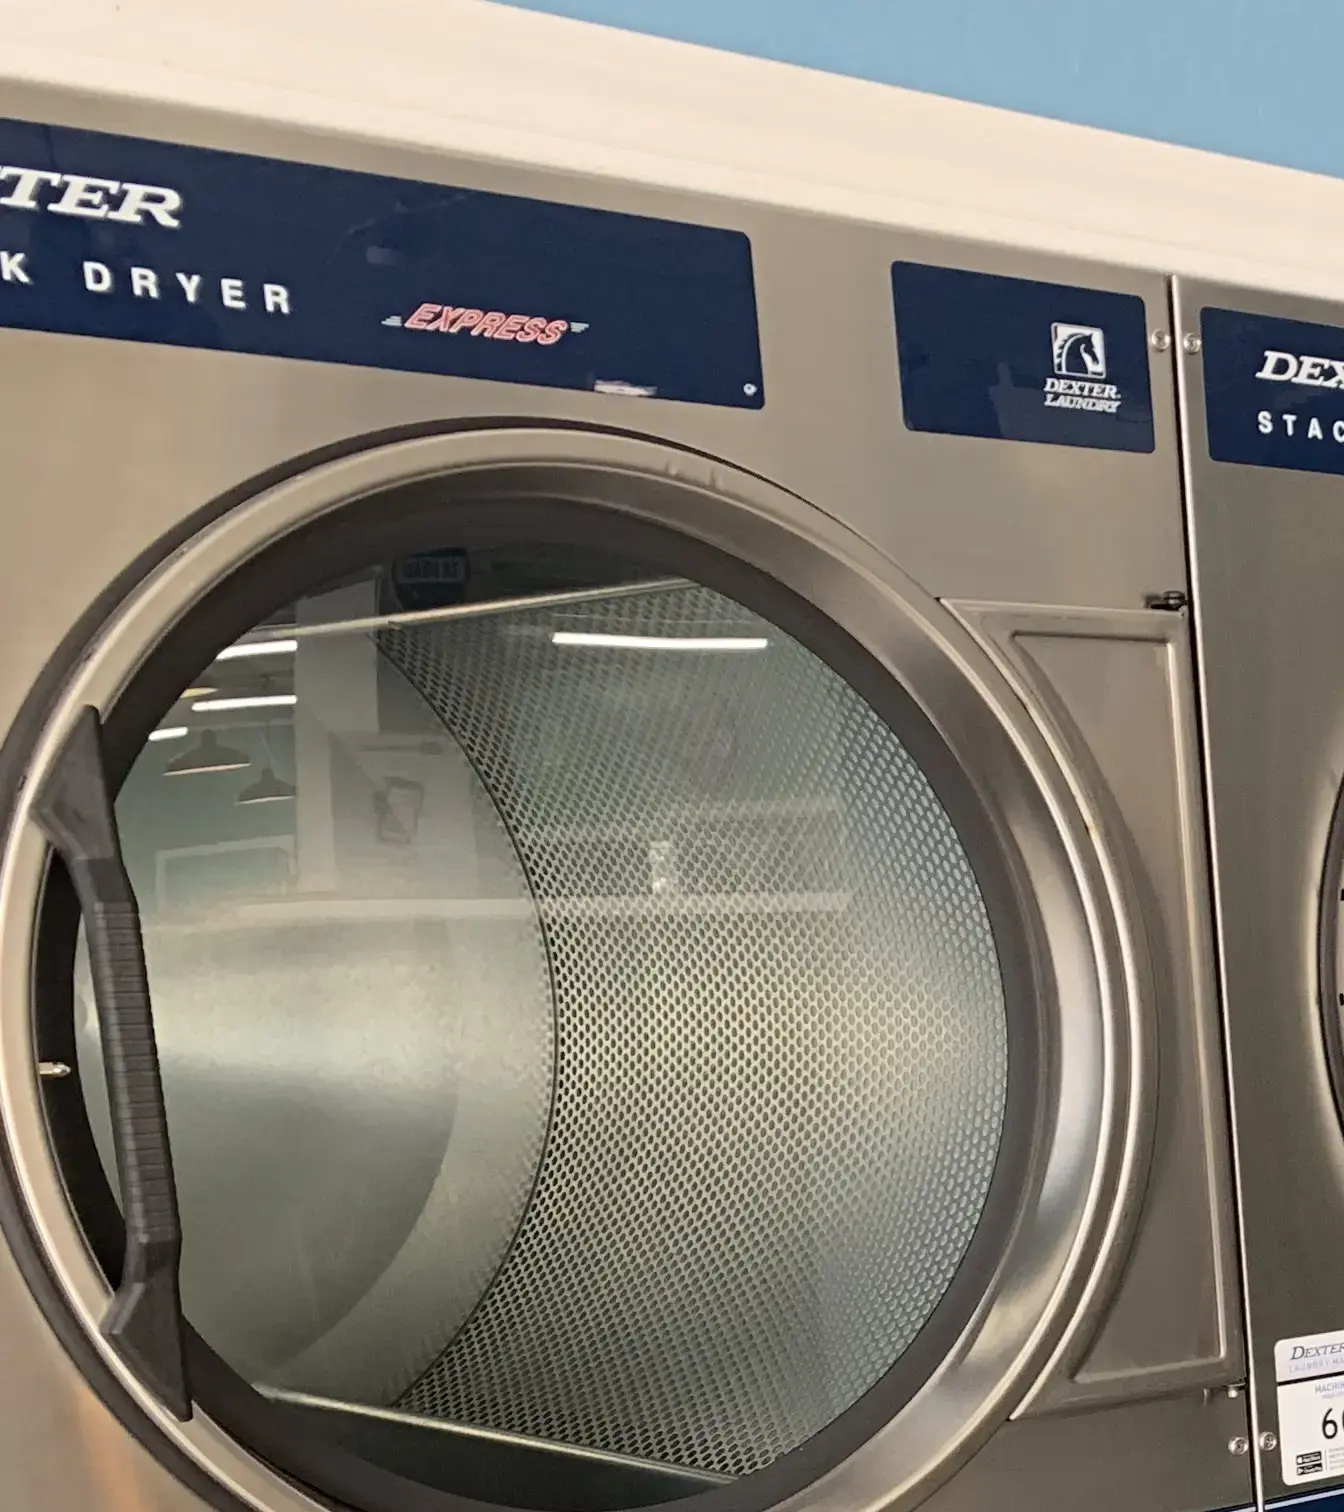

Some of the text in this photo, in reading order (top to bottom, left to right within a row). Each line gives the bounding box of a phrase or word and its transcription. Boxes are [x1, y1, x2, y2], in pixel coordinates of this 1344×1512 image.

[82, 260, 292, 315] DRYER
[404, 302, 570, 346] EXPRESS
[1043, 377, 1119, 399] DEXTER
[1043, 393, 1121, 413] LAUNDRY
